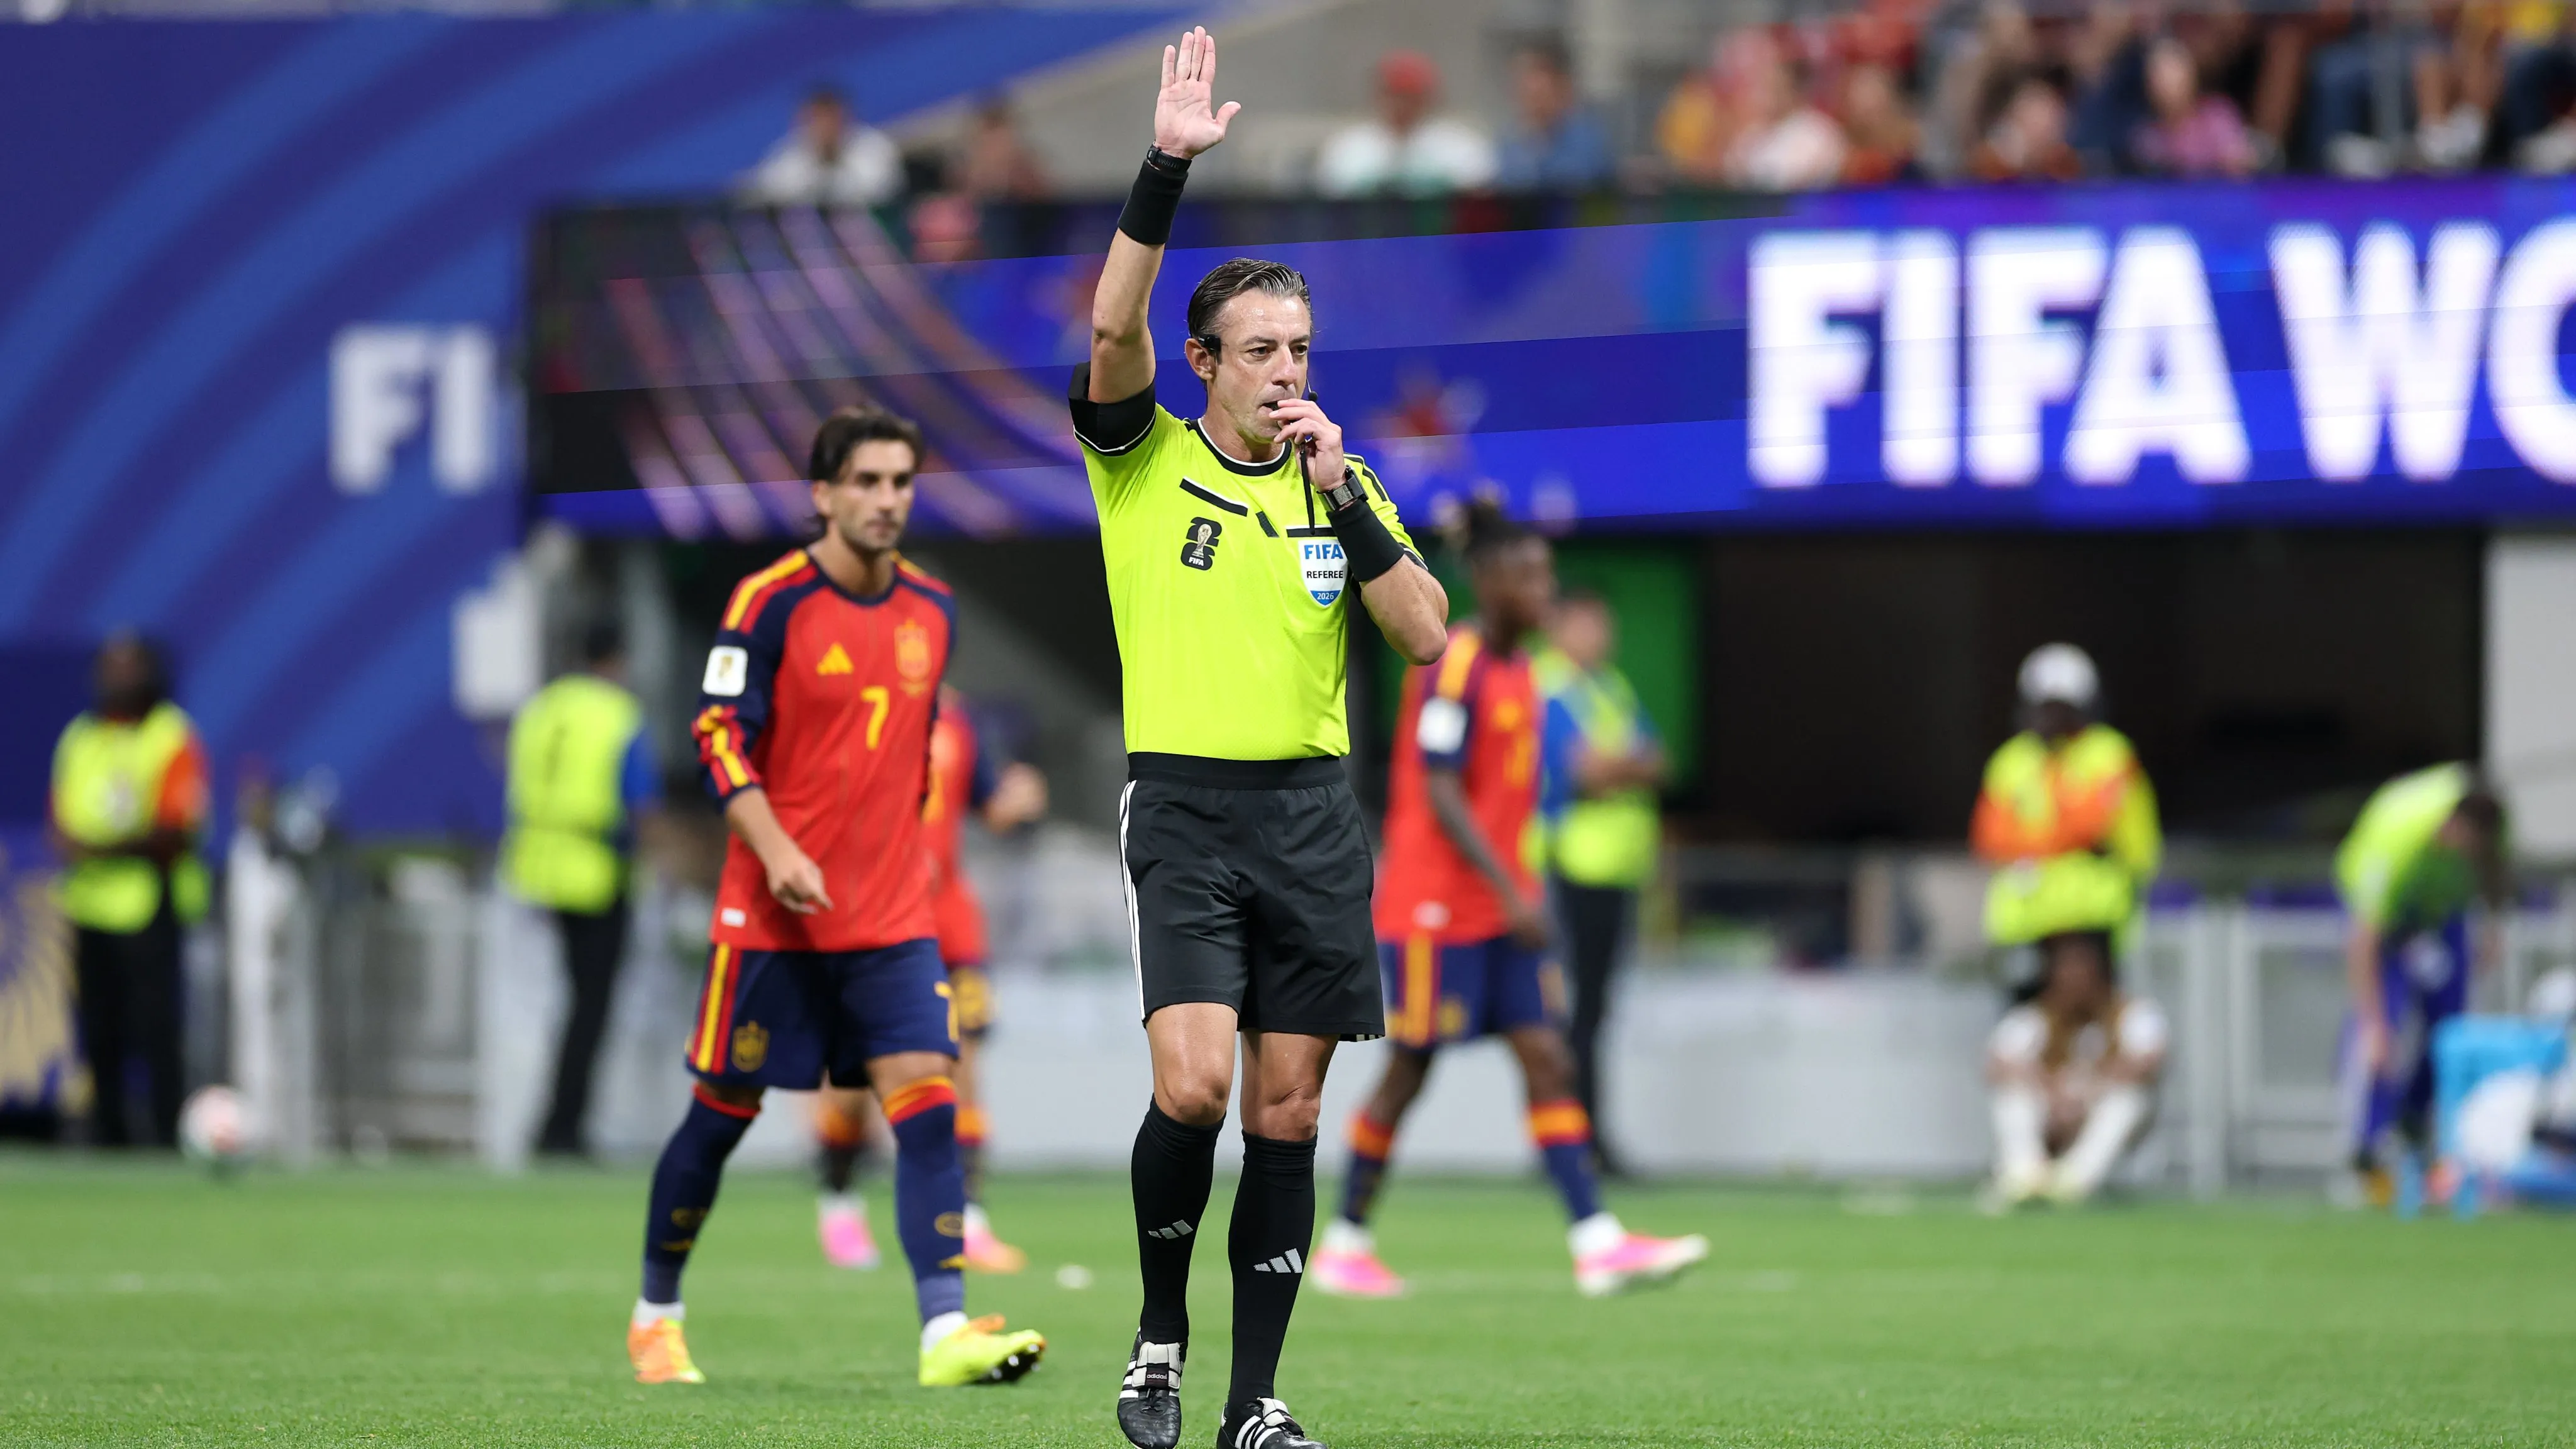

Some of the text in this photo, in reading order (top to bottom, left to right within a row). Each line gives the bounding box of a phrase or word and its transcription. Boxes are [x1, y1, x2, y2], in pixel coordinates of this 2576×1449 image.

[1747, 225, 2251, 487] FIFA
[1304, 544, 1344, 560] FIFA
[1188, 557, 1204, 567] FIFA
[1306, 570, 1344, 579] REFEREE
[1317, 592, 1334, 601] 2026
[860, 685, 890, 750] 7
